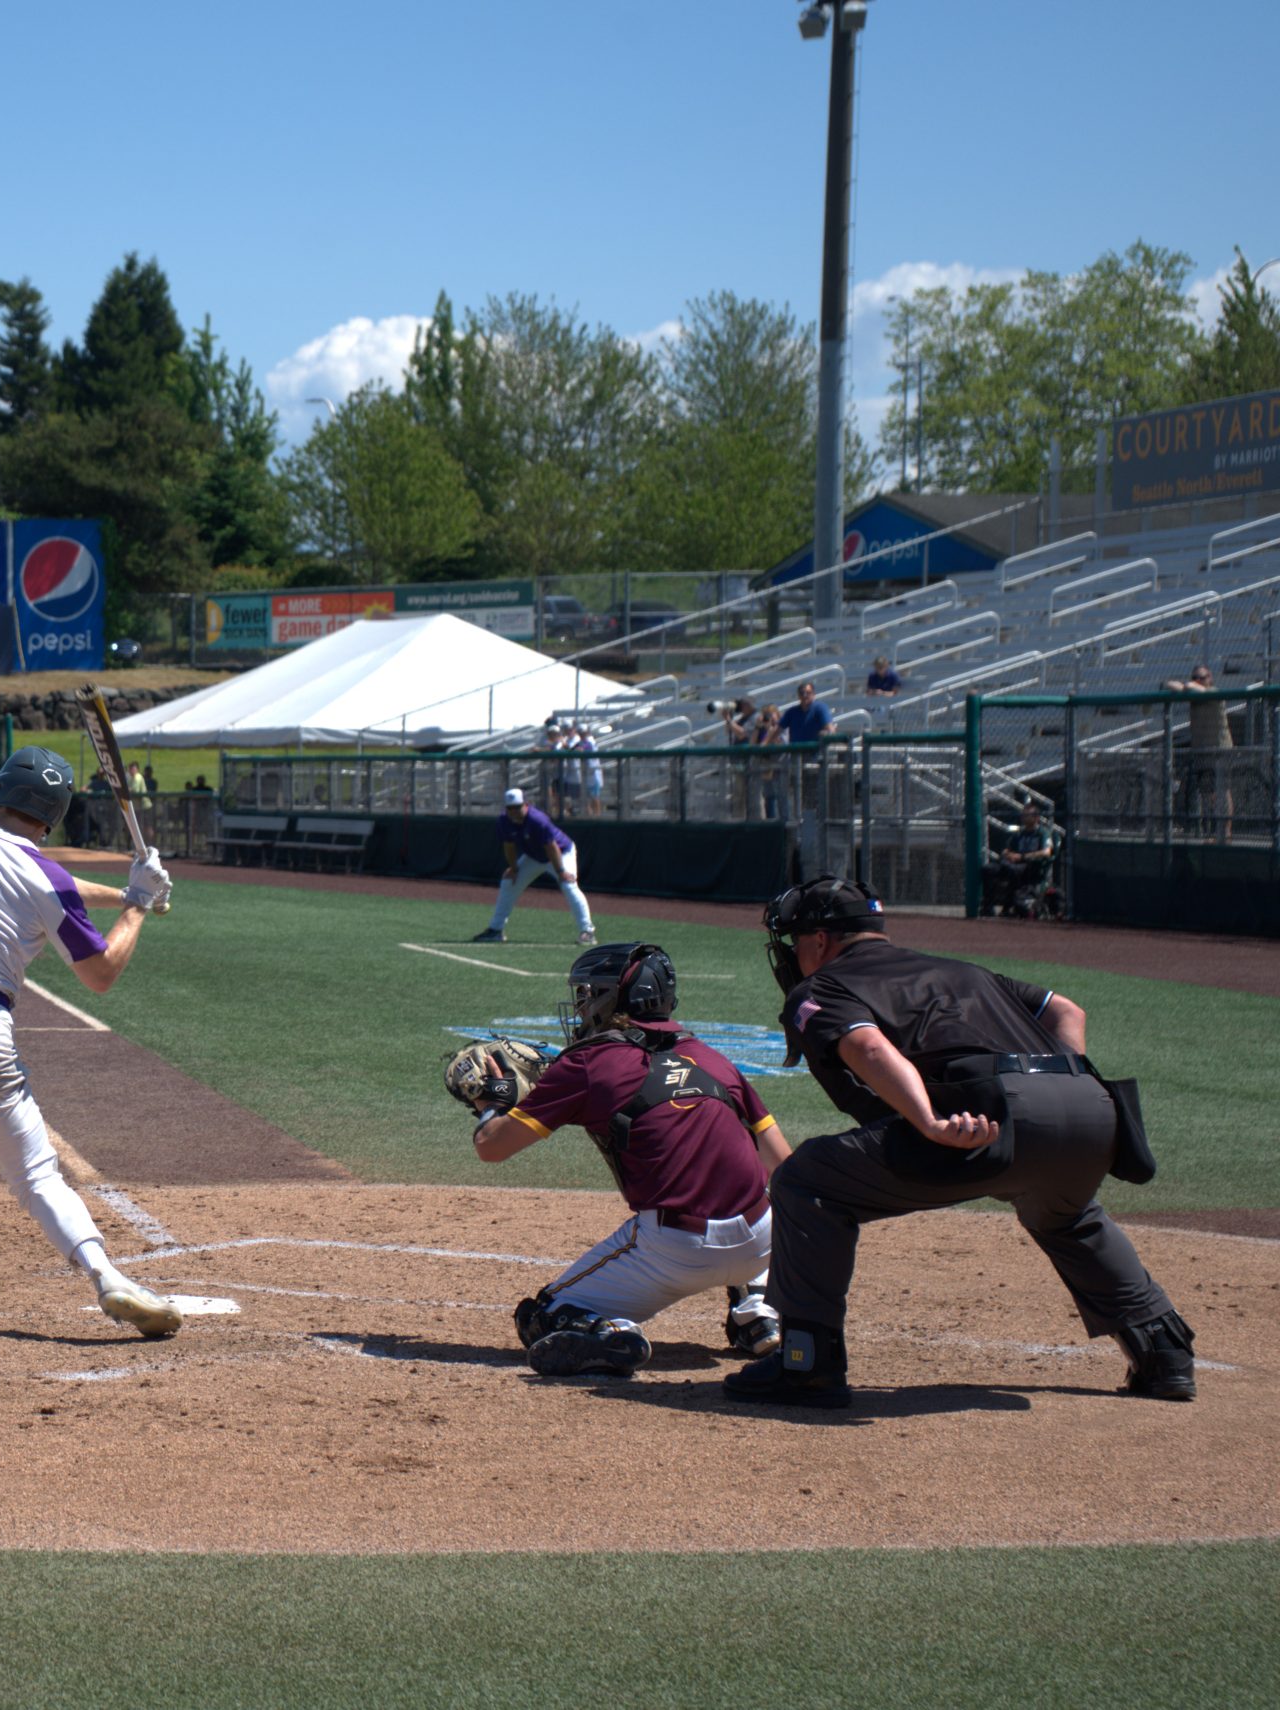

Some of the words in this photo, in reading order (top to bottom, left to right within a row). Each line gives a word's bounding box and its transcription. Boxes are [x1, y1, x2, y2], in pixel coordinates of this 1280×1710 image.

[1214, 454, 1227, 470] BY
[1231, 445, 1280, 467] MARRIOT
[224, 605, 268, 626] fewer
[287, 598, 322, 614] MORE
[277, 616, 323, 642] game
[28, 629, 93, 655] pepsi
